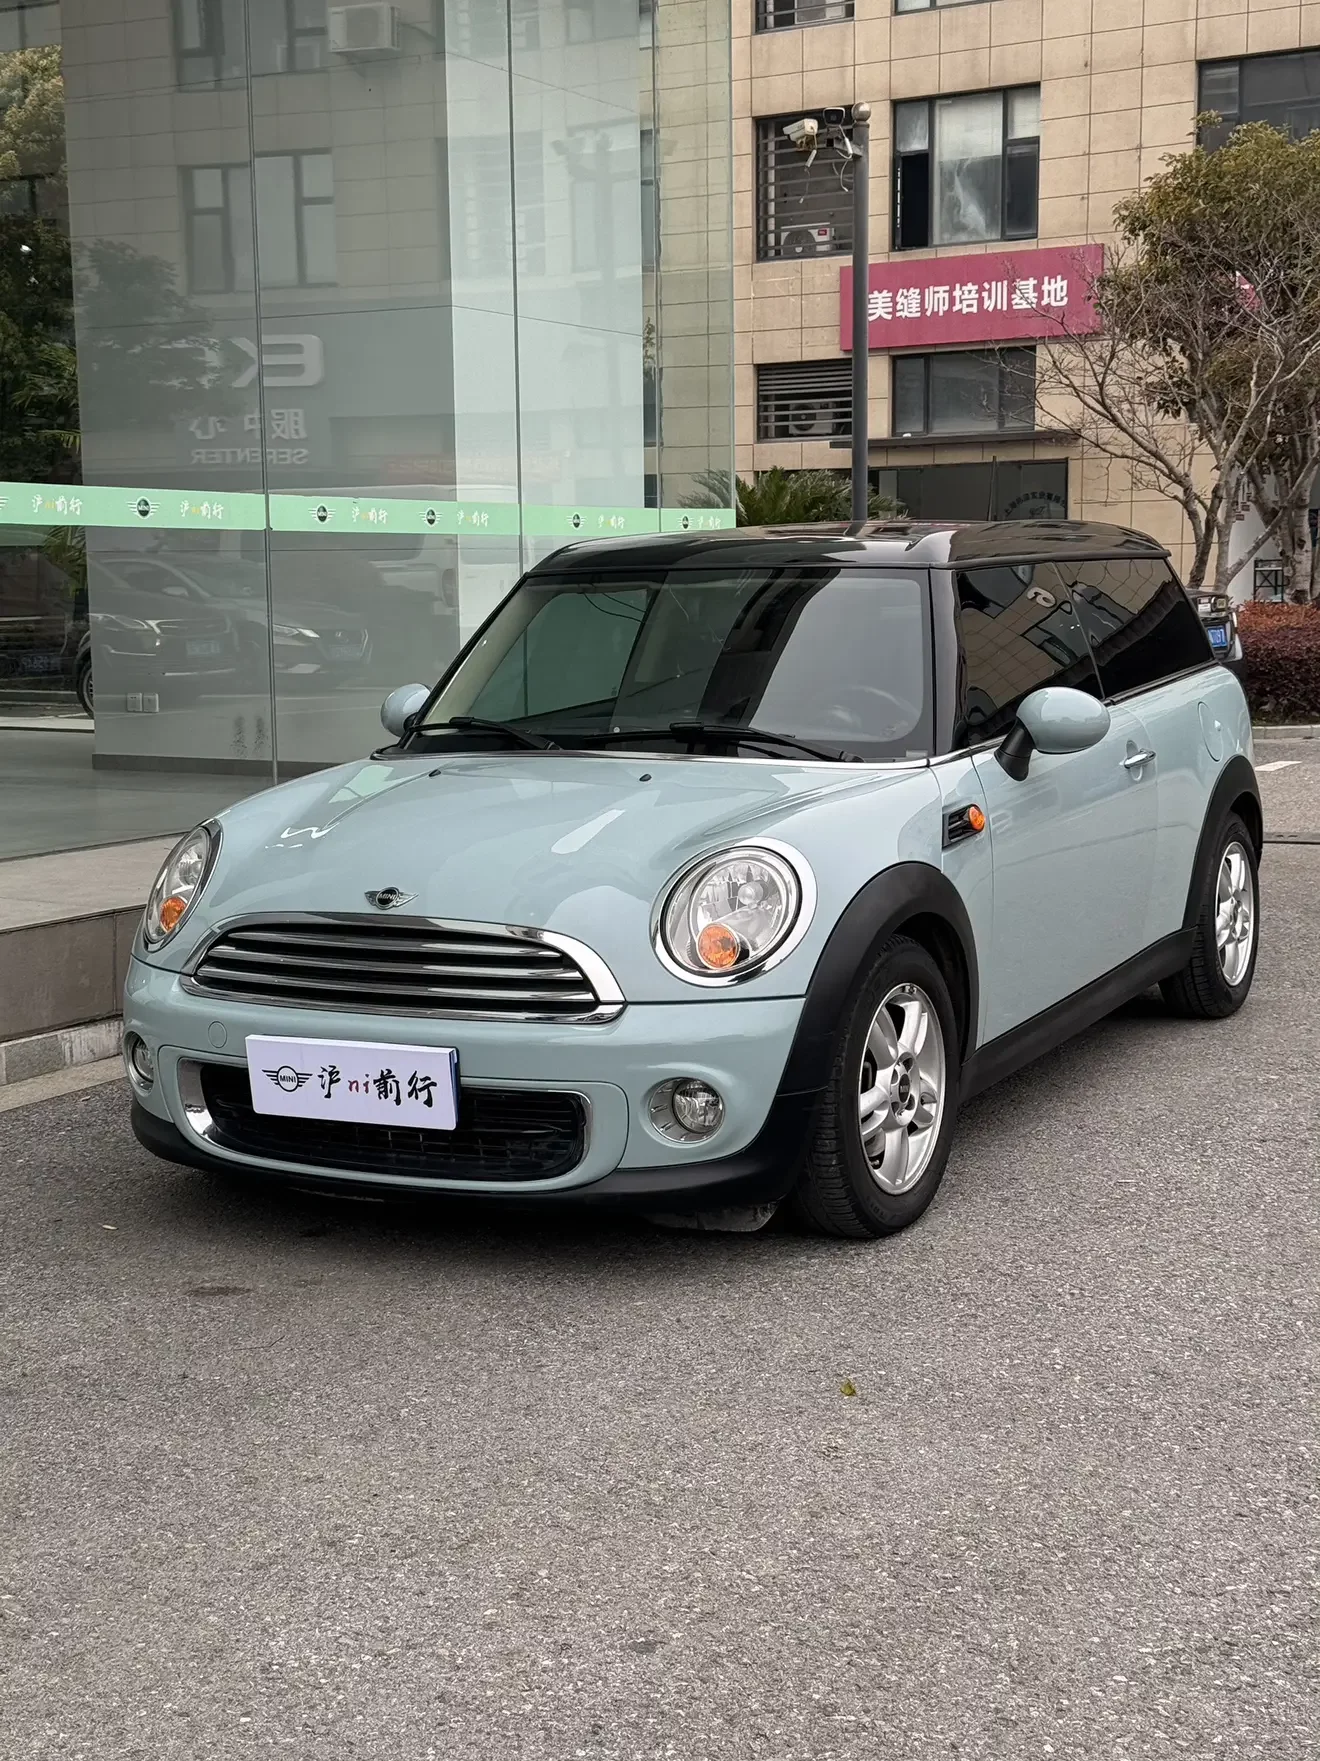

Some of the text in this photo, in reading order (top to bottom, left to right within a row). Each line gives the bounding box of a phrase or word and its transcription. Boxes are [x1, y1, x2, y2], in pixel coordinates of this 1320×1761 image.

[868, 275, 1069, 321] 美缝师培训基地
[279, 1074, 297, 1083] MINI
